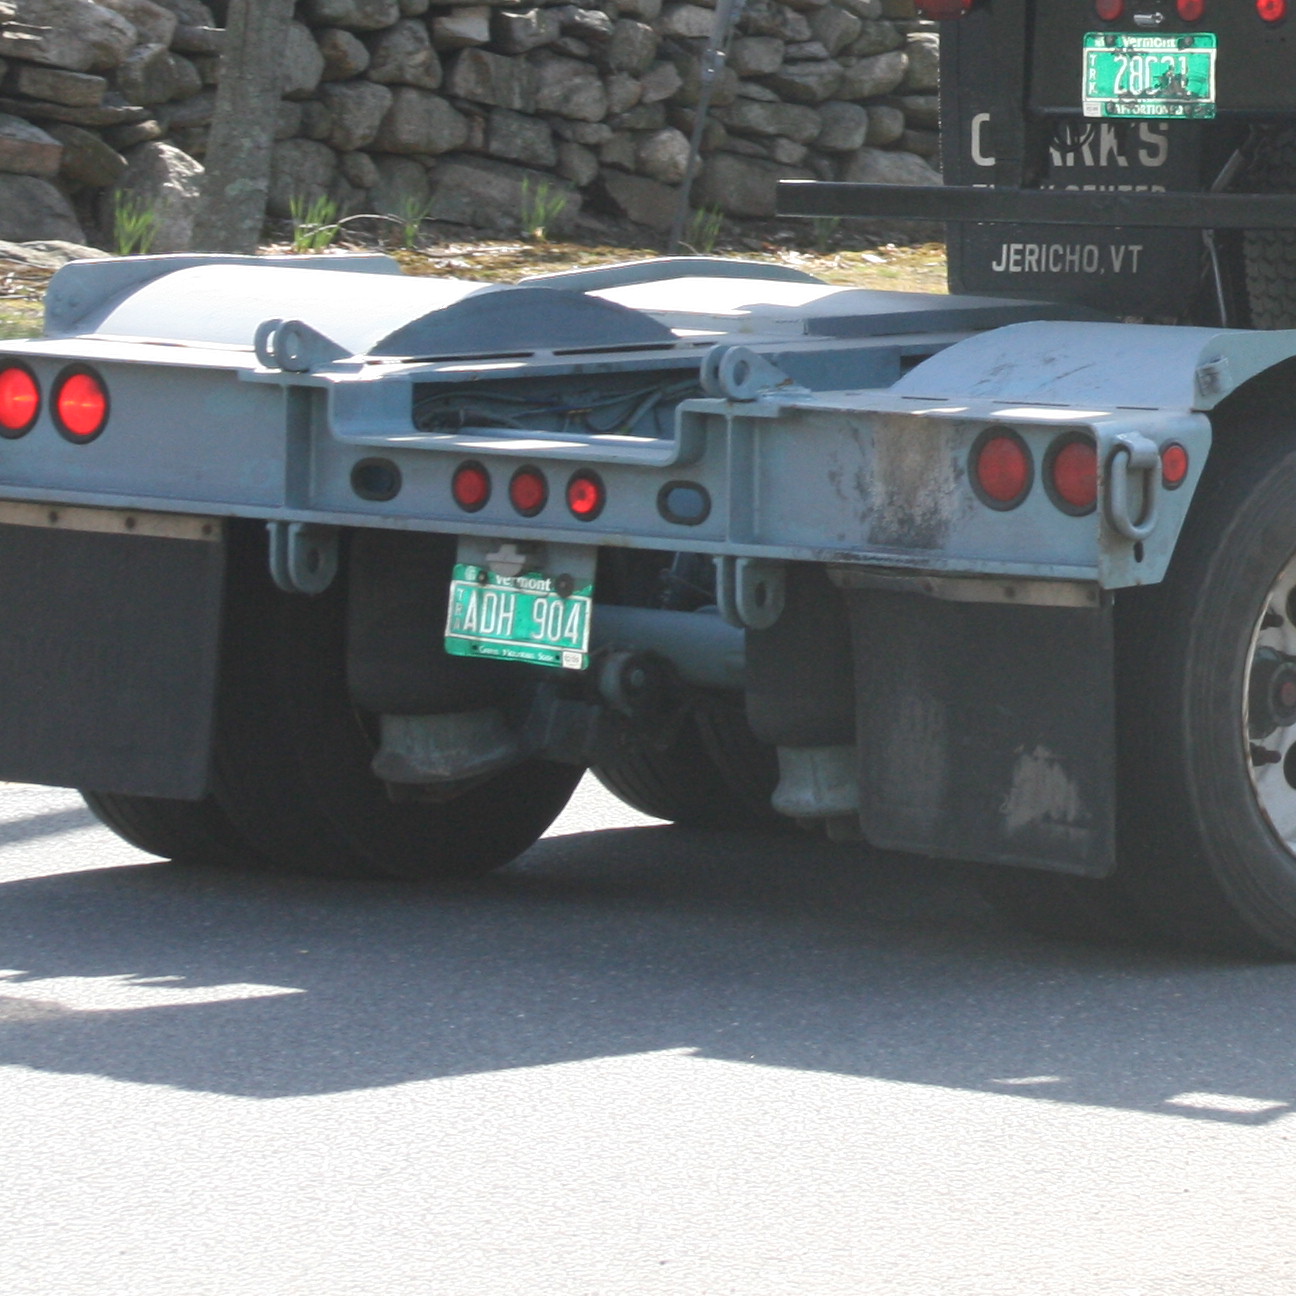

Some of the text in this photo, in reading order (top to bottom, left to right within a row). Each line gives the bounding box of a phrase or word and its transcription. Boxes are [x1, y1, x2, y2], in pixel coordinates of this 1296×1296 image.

[970, 112, 1169, 167] CRKS
[496, 575, 551, 591] Vemont
[465, 590, 581, 644] ADH 904
